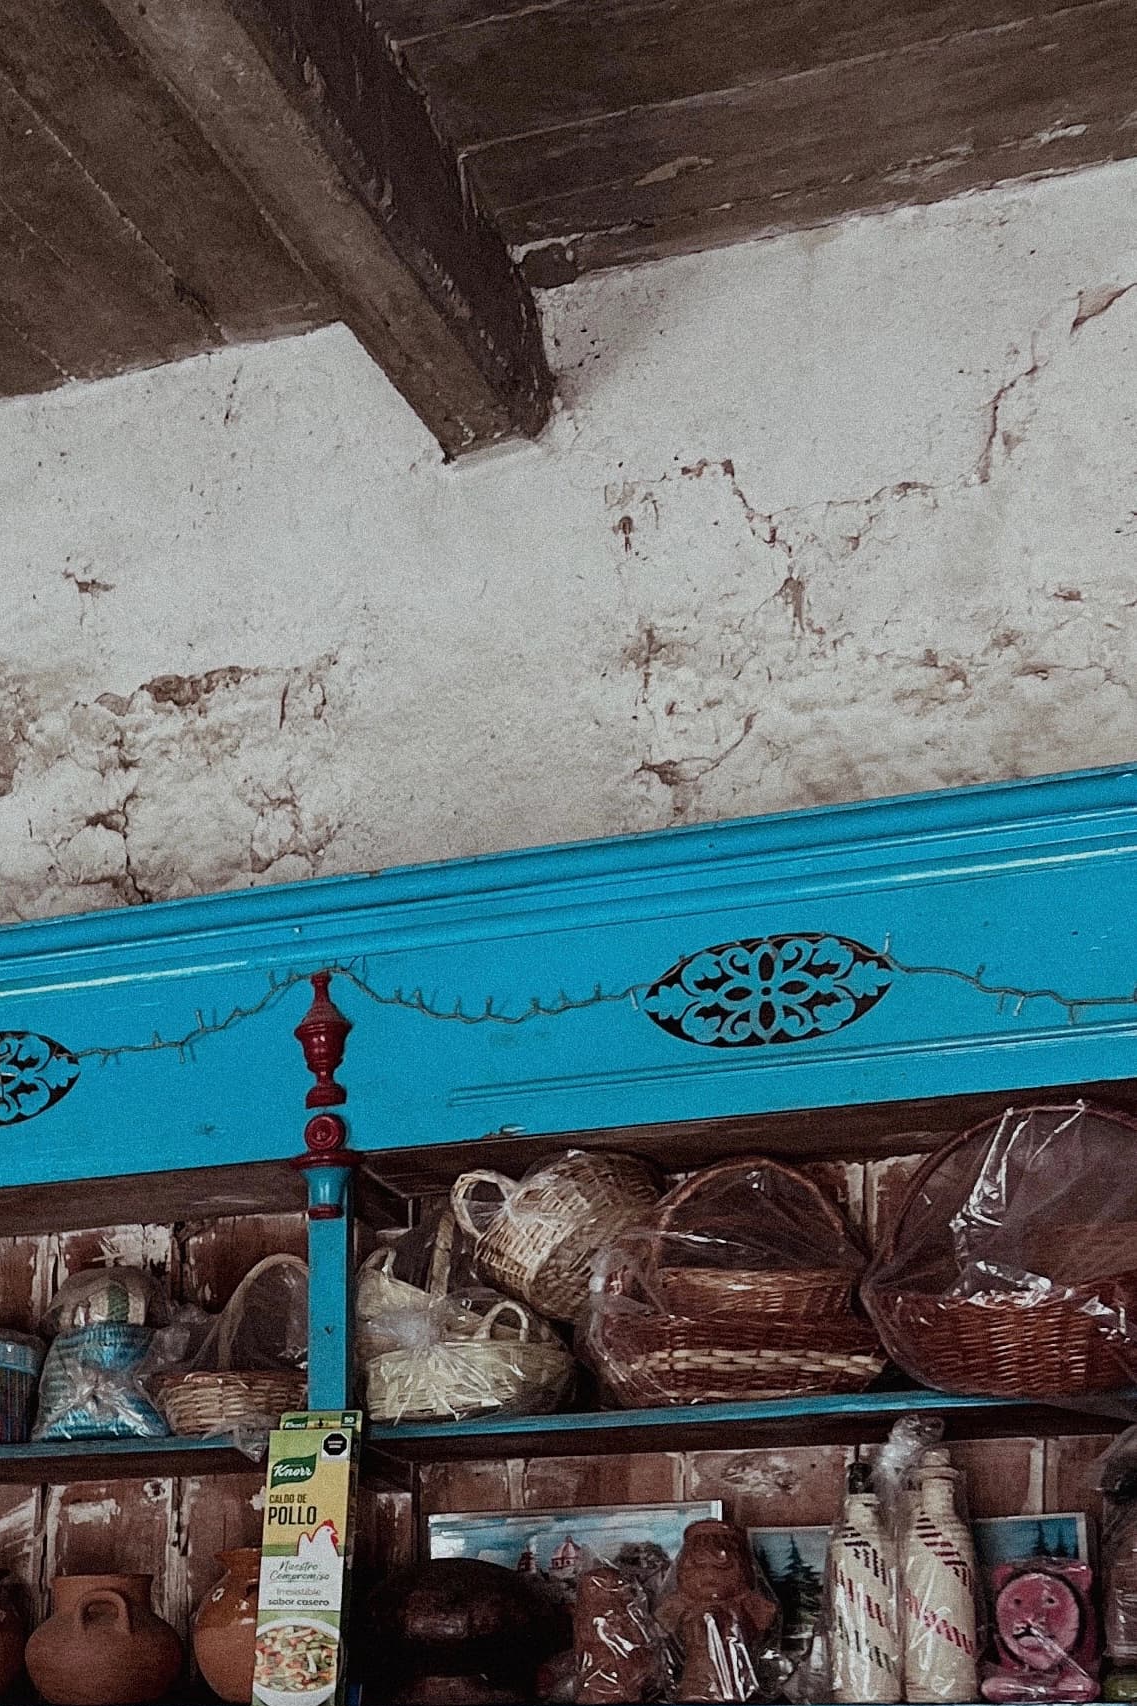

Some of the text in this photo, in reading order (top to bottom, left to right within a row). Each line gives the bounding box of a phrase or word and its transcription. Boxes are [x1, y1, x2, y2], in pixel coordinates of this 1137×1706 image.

[273, 1464, 312, 1477] Knorr
[269, 1494, 307, 1504] CALDO DE
[268, 1506, 317, 1525] POLLO
[279, 1560, 319, 1571] Nuestro
[269, 1570, 329, 1583] Compromiso
[268, 1598, 294, 1606] sabor
